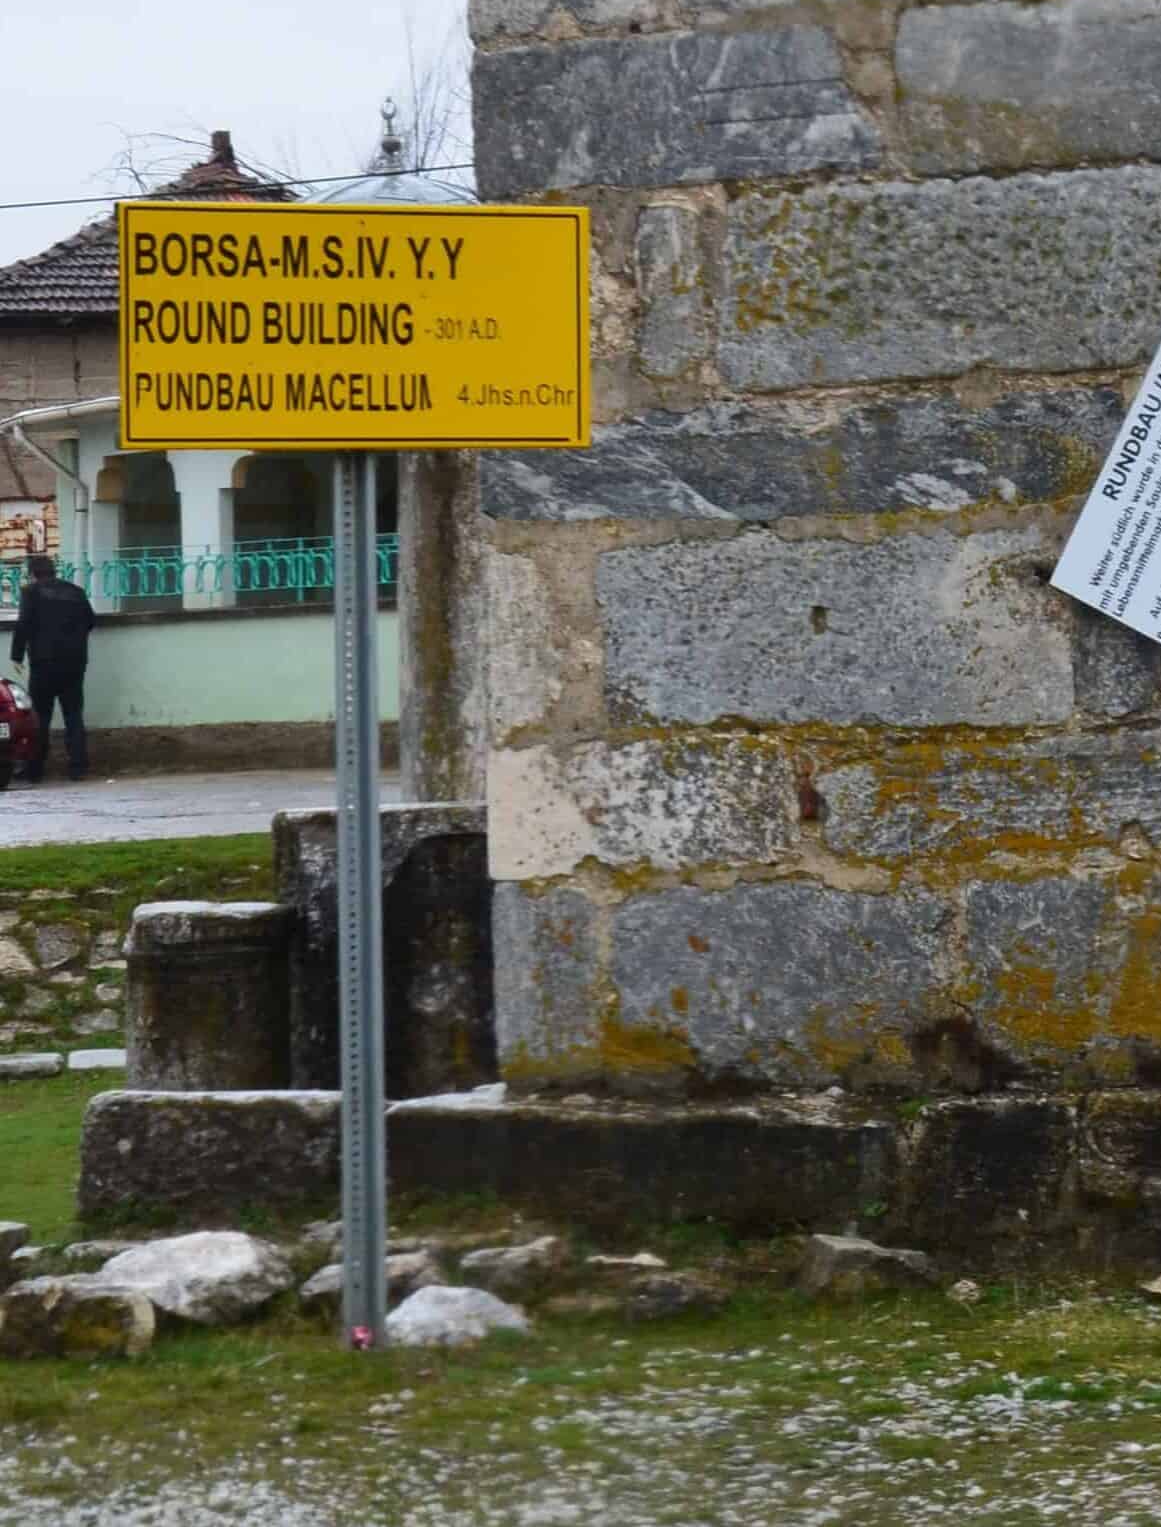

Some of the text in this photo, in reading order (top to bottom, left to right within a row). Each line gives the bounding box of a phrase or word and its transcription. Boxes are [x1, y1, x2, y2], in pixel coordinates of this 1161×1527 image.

[135, 300, 250, 344] ROUND
[263, 302, 413, 345] BUILDING
[1089, 547, 1116, 589] Weiter
[1108, 503, 1137, 548] südlich
[1128, 463, 1156, 504] wurde
[1147, 450, 1161, 465] in
[1097, 588, 1114, 610] mit
[1107, 508, 1154, 590] umgebenden
